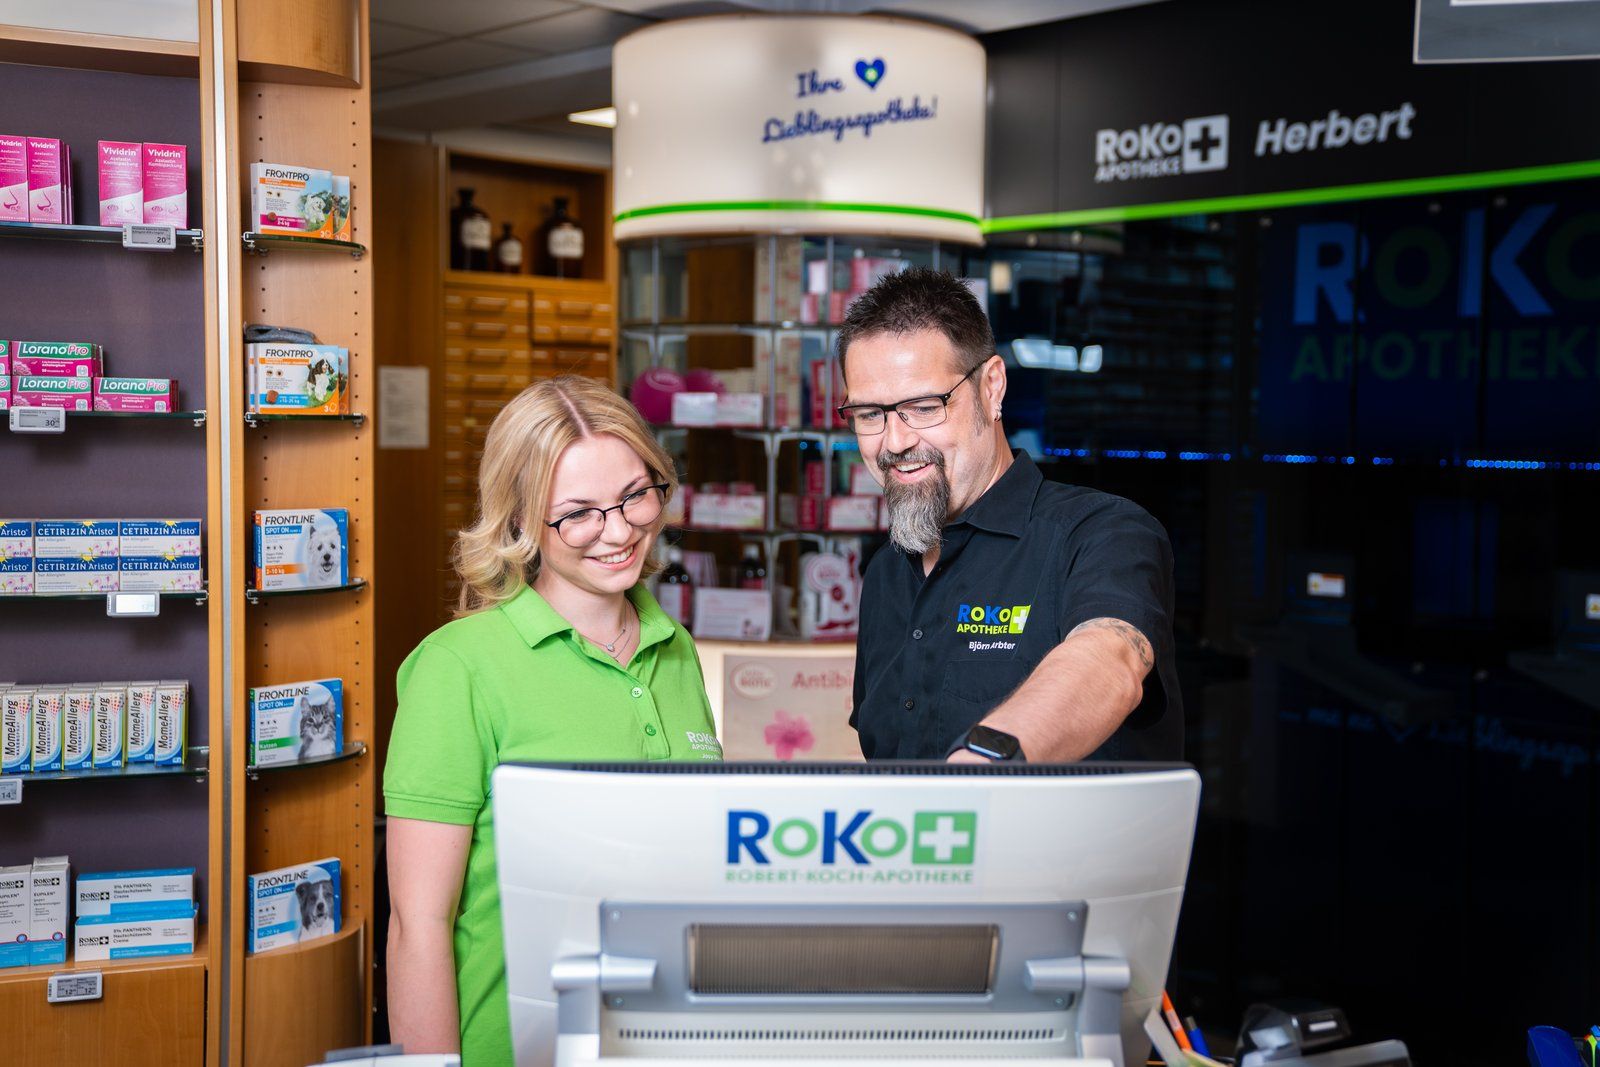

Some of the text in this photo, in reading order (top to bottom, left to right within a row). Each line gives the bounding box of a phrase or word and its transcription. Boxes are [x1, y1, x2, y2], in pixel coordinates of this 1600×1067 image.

[796, 69, 845, 98] Ihre
[1254, 102, 1416, 157] Herbert
[103, 147, 137, 156] Vividrin
[148, 149, 181, 158] Vividrin
[265, 169, 310, 181] FRONTPRO
[1094, 155, 1182, 183] APOTHEKE
[266, 348, 314, 358] FRONTPRO
[1289, 326, 1600, 381] APOTHEK
[265, 514, 315, 525] FRONTLINE
[956, 623, 1009, 635] APOTHEKE
[968, 640, 990, 652] Björn
[259, 686, 310, 700] FRONTLINE
[5, 700, 18, 756] MomeAllerg
[36, 699, 48, 754] MomeAllerg
[67, 698, 80, 753] MomeAllerg
[97, 697, 110, 752] MomeAllerg
[130, 692, 143, 746] MomeAllerg
[158, 695, 171, 749] MomeAllerg
[258, 870, 308, 888] FRONTLINE
[258, 888, 273, 898] SPOT
